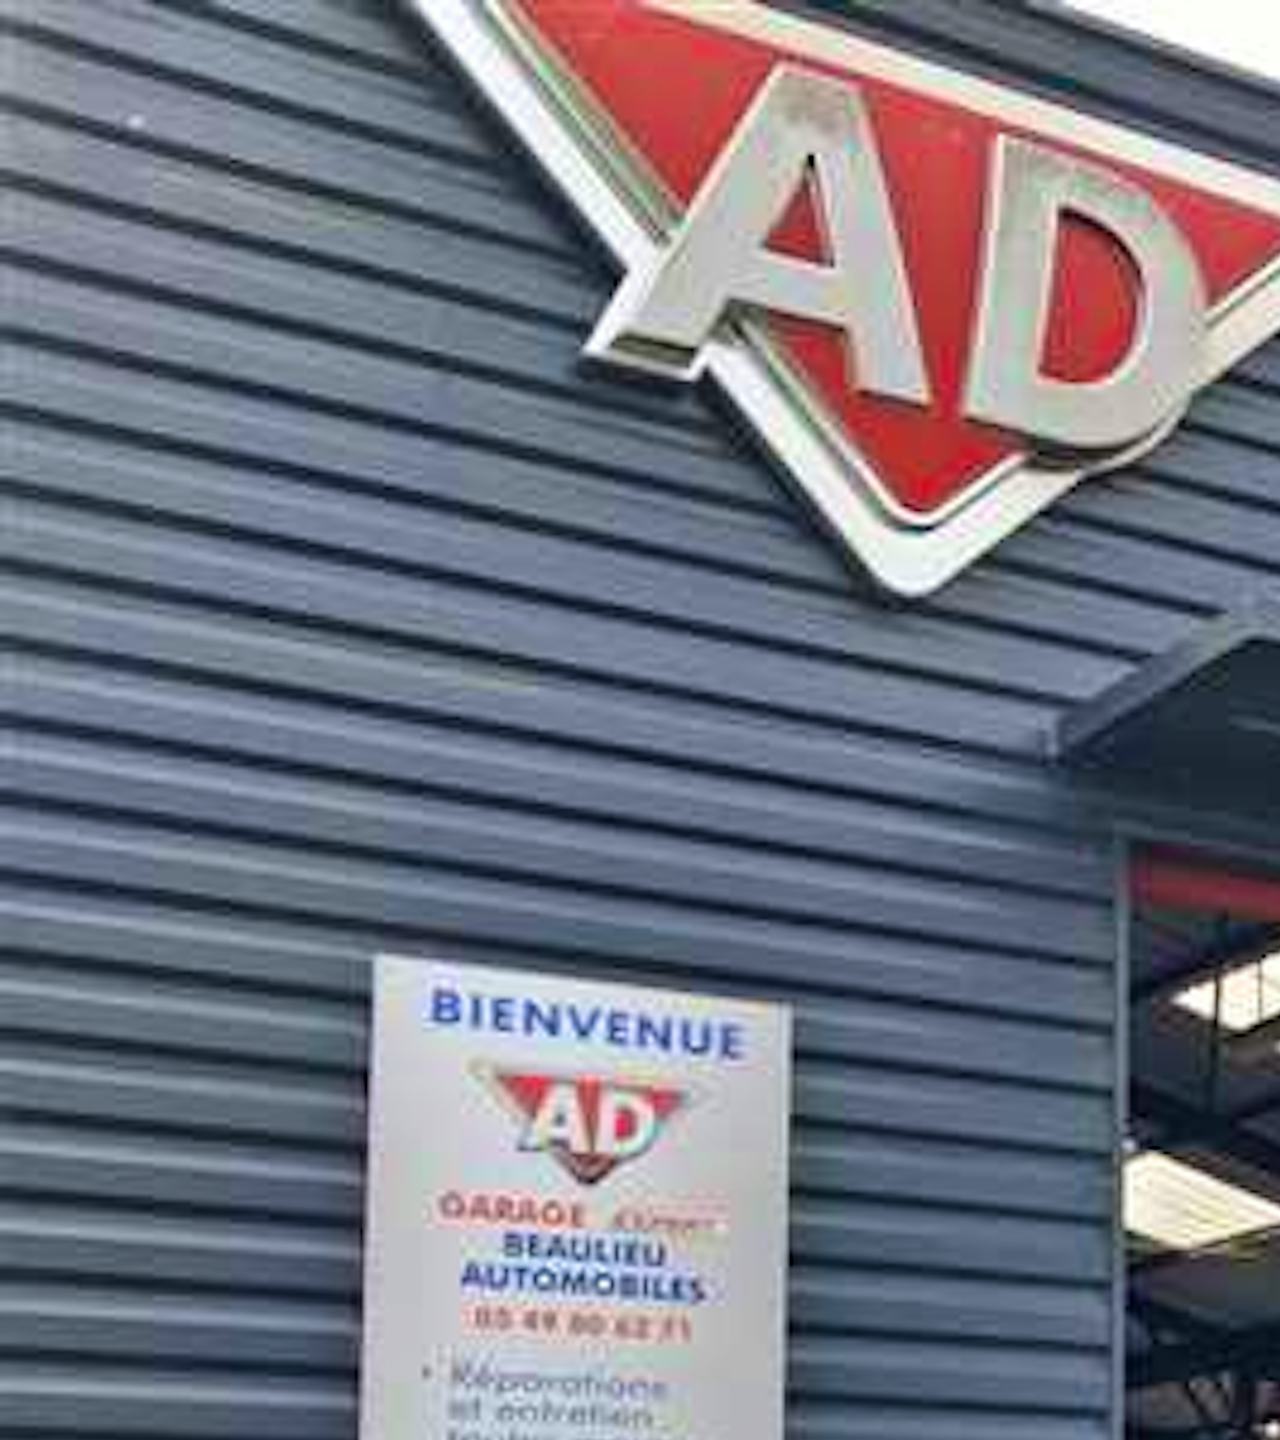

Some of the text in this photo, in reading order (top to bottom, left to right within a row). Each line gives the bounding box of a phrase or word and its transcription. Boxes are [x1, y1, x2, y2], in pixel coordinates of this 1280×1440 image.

[586, 58, 1211, 455] AD
[429, 986, 747, 1061] BIENVENUE
[516, 1079, 657, 1156] AD
[438, 1190, 586, 1230] GARAGE
[502, 1232, 667, 1268] BEAULIEU
[461, 1260, 707, 1305] AUTOMOBILES
[450, 1360, 668, 1400] Réparations
